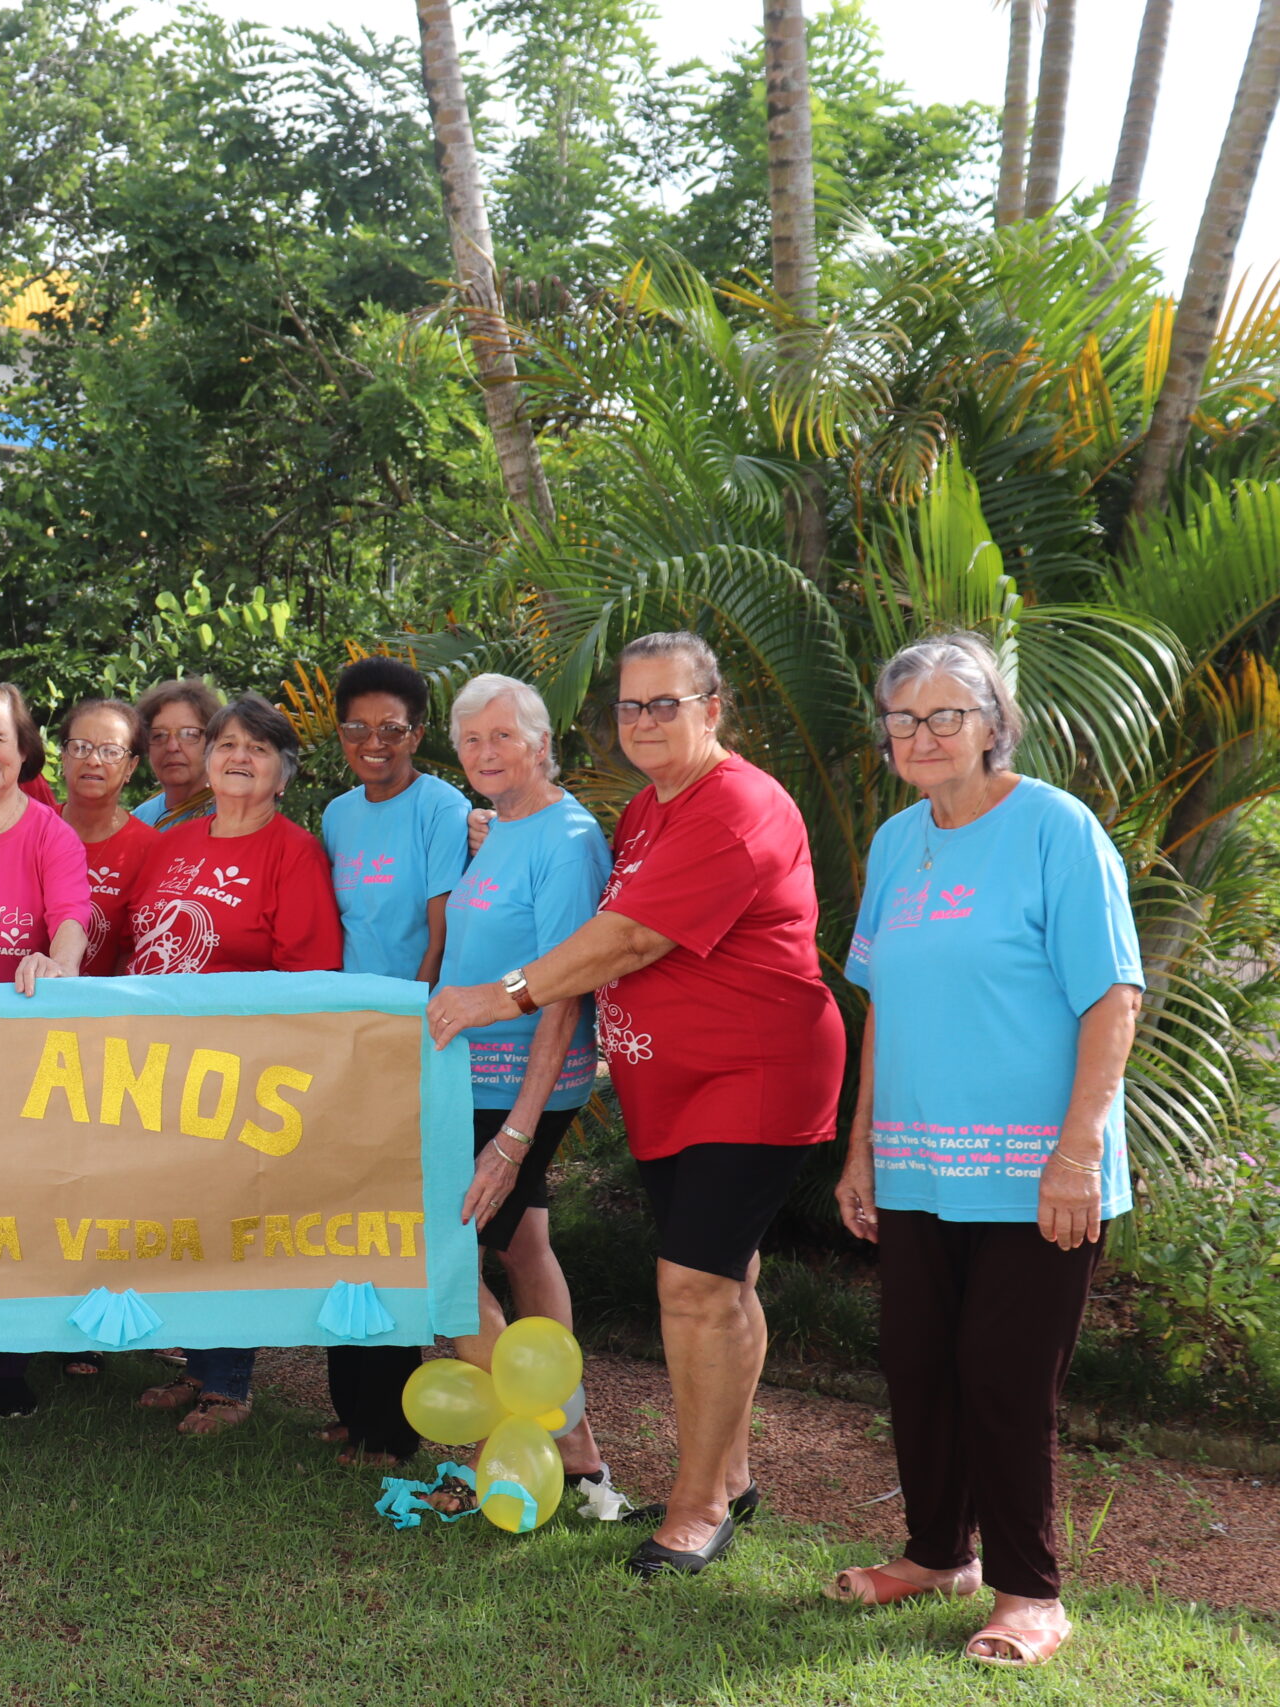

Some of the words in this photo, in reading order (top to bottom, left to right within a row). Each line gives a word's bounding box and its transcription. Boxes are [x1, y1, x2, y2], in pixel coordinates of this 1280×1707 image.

[89, 884, 121, 896] CCAT
[193, 886, 243, 908] FACCAT
[469, 1043, 515, 1052] FACCAT
[469, 1054, 499, 1062] Coral
[471, 1075, 500, 1083] Coral
[20, 1030, 313, 1157] ANOS
[959, 1126, 969, 1135] a
[972, 1123, 1004, 1136] Vida
[1007, 1124, 1059, 1136] FACCAT
[940, 1138, 991, 1149] FACCAT
[1005, 1139, 1042, 1150] Coral
[956, 1154, 967, 1164] a
[970, 1151, 1001, 1164] Vida
[1004, 1152, 1050, 1165] FACCA
[941, 1166, 991, 1178] FACCAT
[1005, 1166, 1042, 1178] Coral
[54, 1216, 206, 1262] VIDA
[231, 1210, 424, 1262] FACCAT
